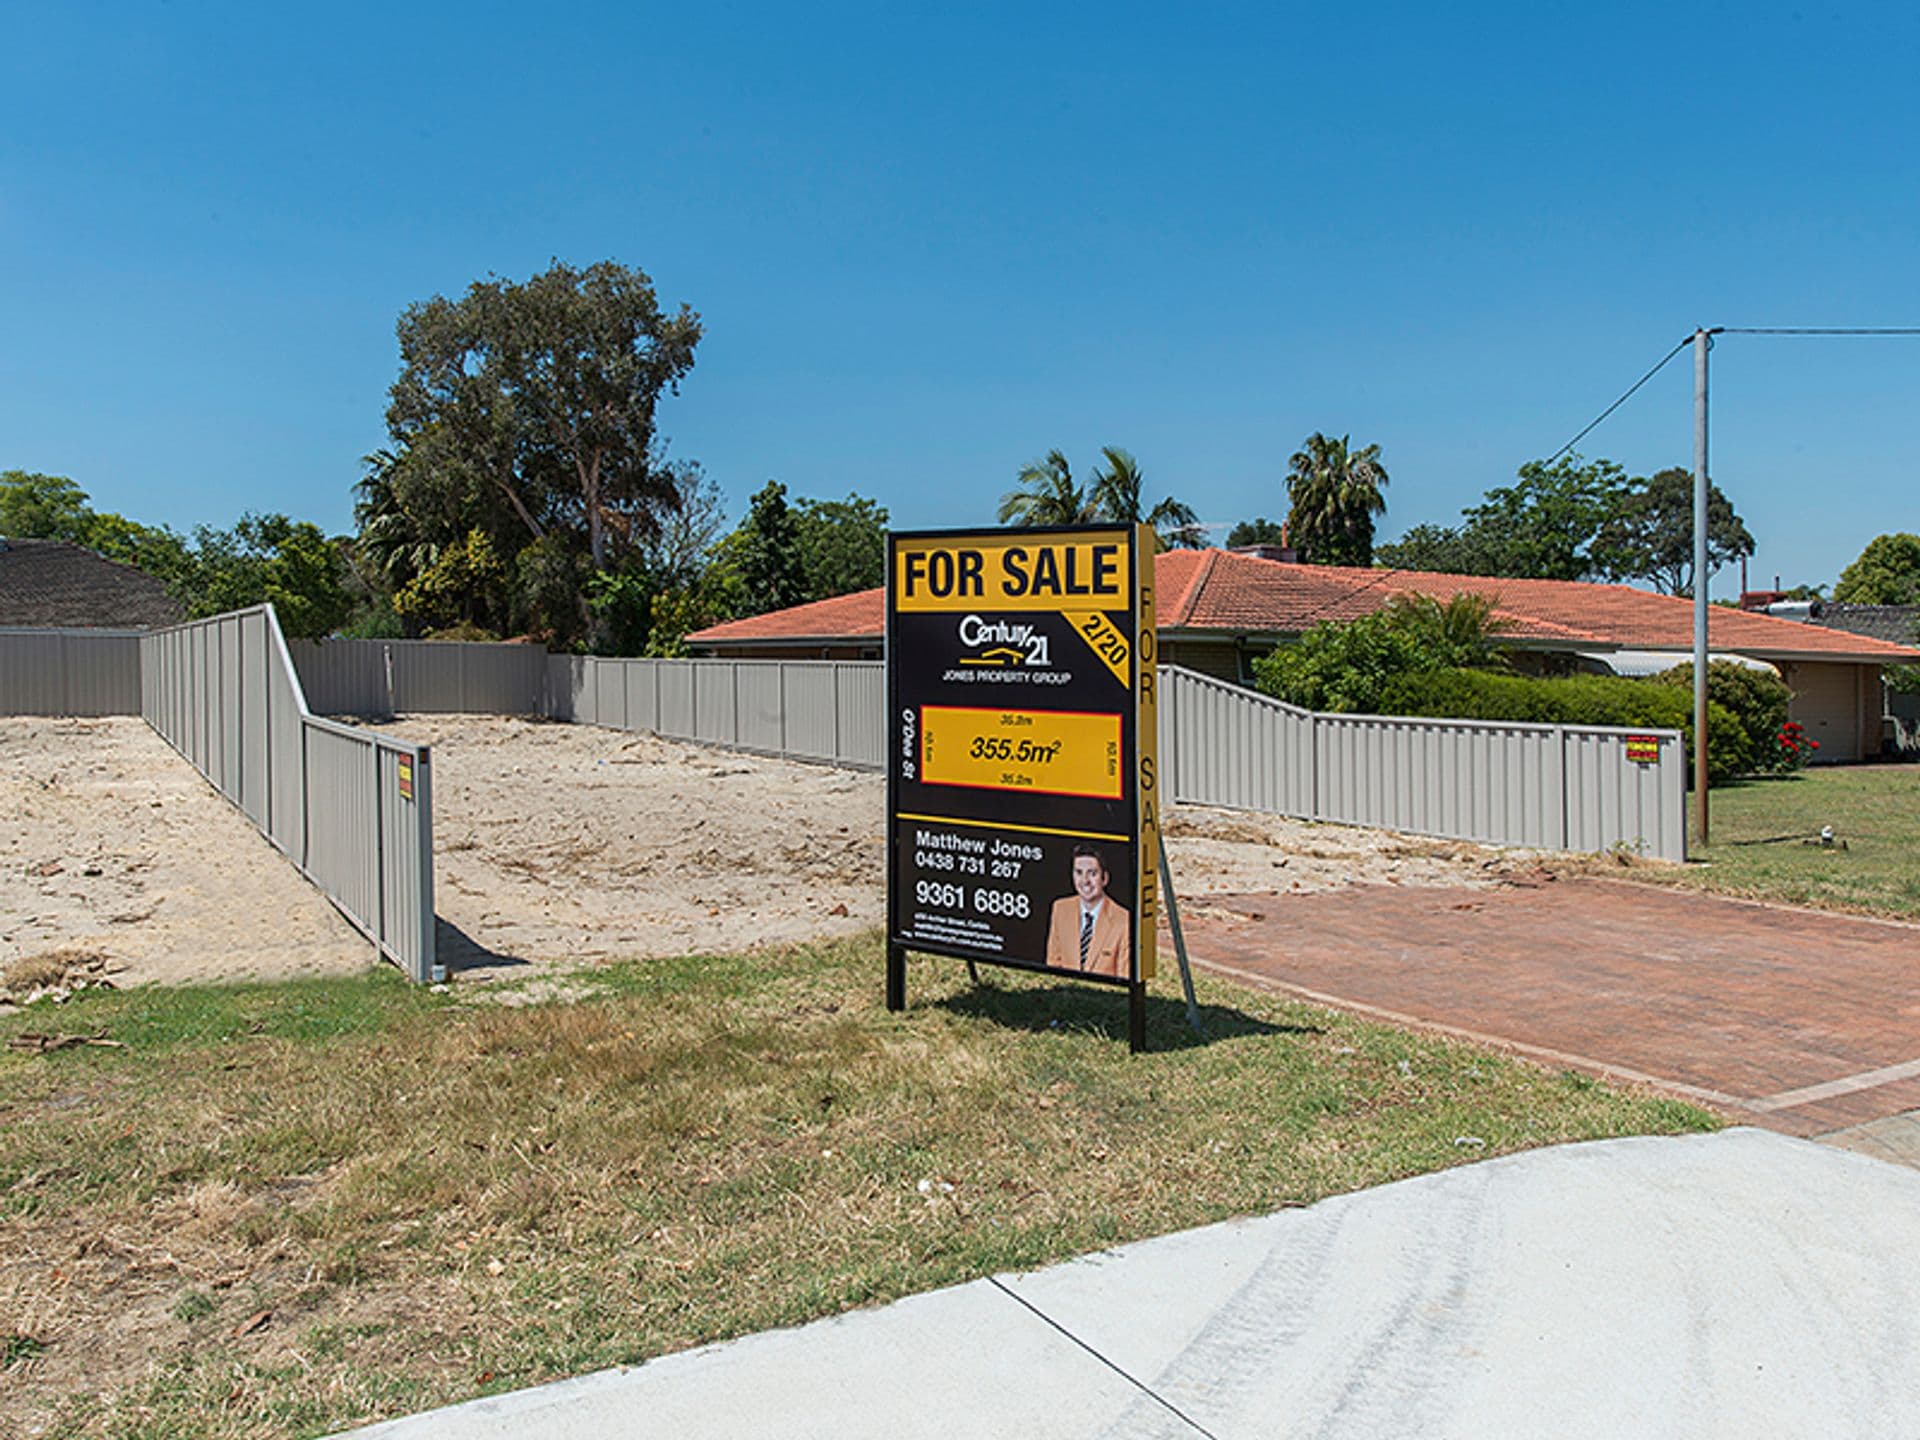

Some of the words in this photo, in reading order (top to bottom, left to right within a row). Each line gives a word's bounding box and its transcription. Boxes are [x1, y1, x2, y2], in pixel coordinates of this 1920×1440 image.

[904, 550, 984, 597] FOR
[1001, 545, 1119, 597] SALE
[959, 614, 1034, 647] Century
[1081, 614, 1128, 667] 2/20
[1140, 587, 1154, 705] FOR
[1025, 635, 1053, 666] 21
[943, 670, 976, 682] JONES
[1032, 671, 1072, 684] GROUP
[916, 830, 986, 854] Matthew
[990, 838, 1043, 861] Jones
[1139, 756, 1157, 919] SALE
[958, 855, 986, 875] 731
[916, 880, 964, 909] 9361
[974, 887, 1032, 919] 6888
